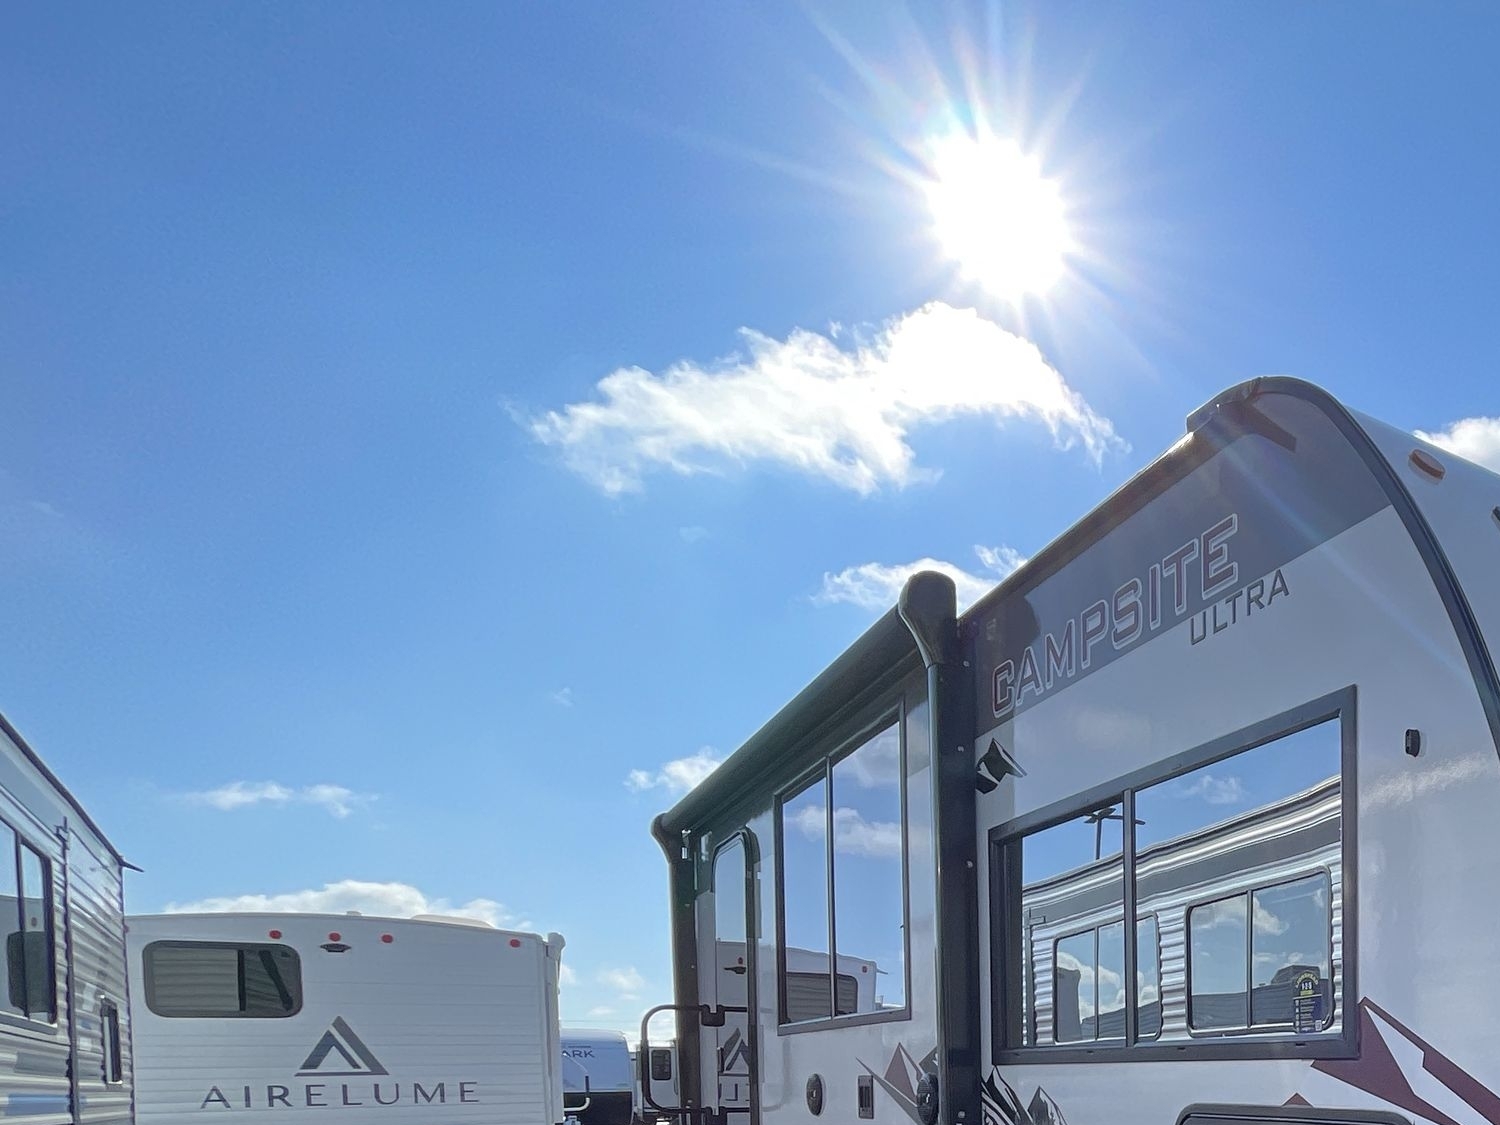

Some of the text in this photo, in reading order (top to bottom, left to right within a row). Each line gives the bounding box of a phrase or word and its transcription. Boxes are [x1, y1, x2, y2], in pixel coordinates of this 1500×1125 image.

[992, 513, 1239, 718] CAMPSITE
[1189, 568, 1290, 646] ULTRA
[201, 1081, 480, 1109] AIRELUME
